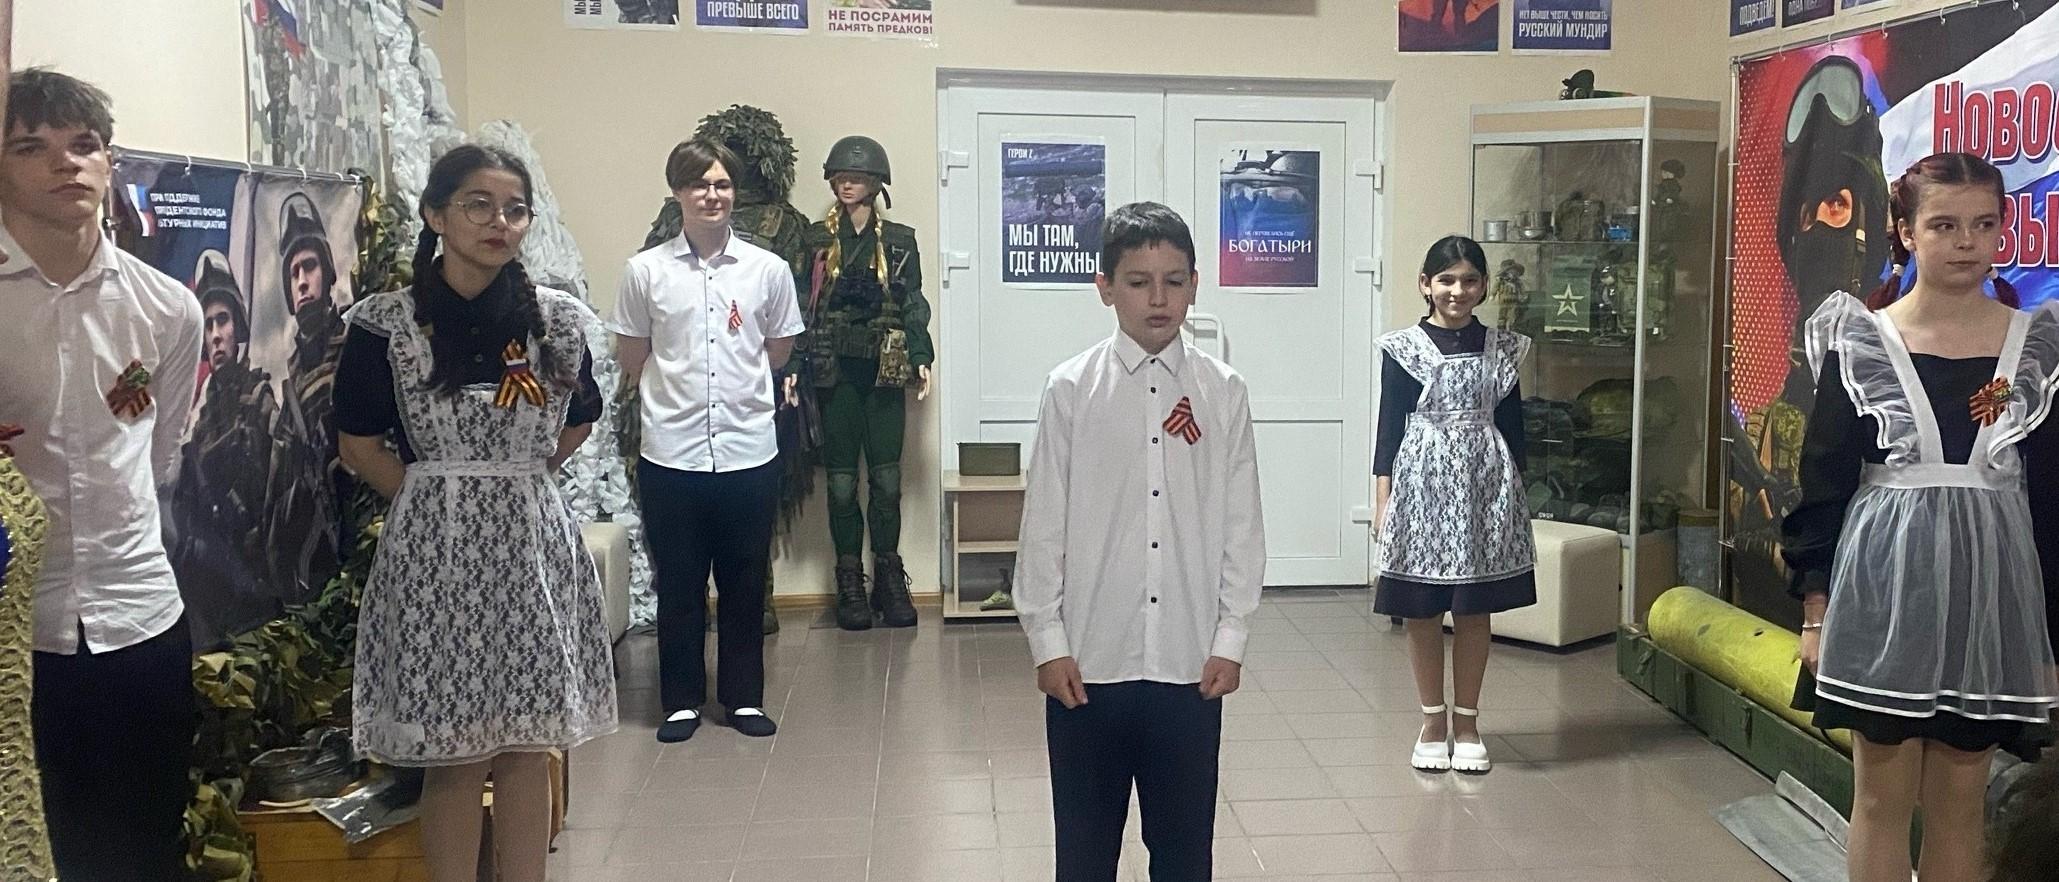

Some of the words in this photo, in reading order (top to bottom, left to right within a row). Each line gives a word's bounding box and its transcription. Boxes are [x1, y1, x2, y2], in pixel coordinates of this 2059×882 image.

[707, 2, 764, 19] ПРЕВЫШЕ
[766, 4, 799, 20] ВСЕГО
[828, 10, 846, 21] НЕ
[850, 11, 933, 24] ПОСРАМИМ
[1572, 10, 1584, 20] ЧЕМ
[828, 23, 874, 33] ПАМЯТЬ
[877, 25, 933, 35] ПРЕДКОВ!
[1519, 20, 1563, 38] РУССКИЙ
[1565, 23, 1608, 40] МУНДИР
[1932, 80, 2059, 163] НОВО
[1009, 224, 1038, 246] МЫ
[1043, 224, 1079, 249] ТАМ,
[1229, 239, 1312, 253] БОГАТЫРИ
[1009, 251, 1035, 277] ГДЕ
[1040, 251, 1100, 273] НУЖНЫ
